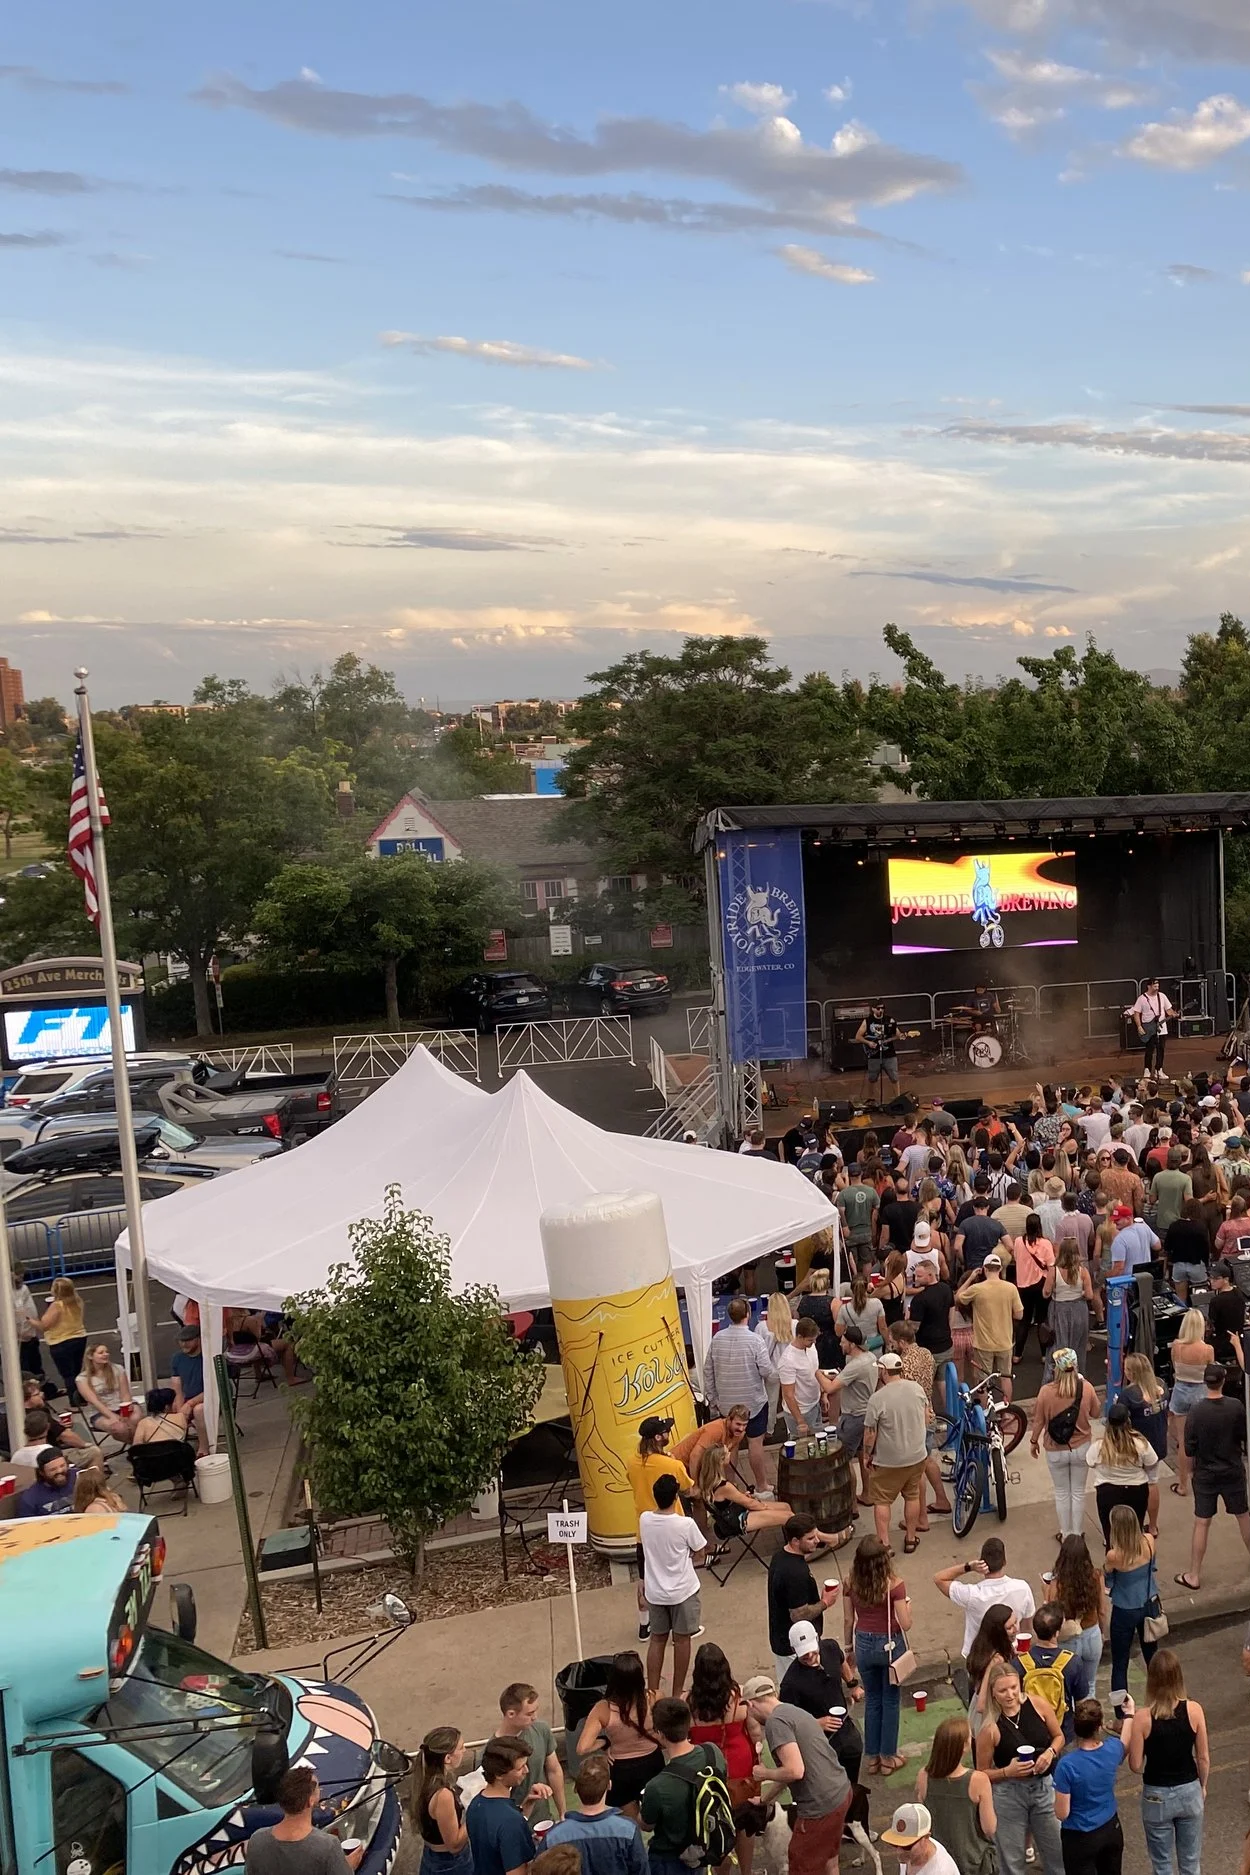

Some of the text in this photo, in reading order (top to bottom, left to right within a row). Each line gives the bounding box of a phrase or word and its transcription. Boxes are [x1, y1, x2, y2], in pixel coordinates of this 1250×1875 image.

[892, 890, 1076, 924] JOYRIDE BREWING
[726, 886, 801, 954] JOYRIDE BREWING
[736, 964, 783, 973] EDGEWATER,
[4, 974, 34, 992] 25th
[37, 971, 61, 983] Ave
[611, 1327, 681, 1366] ICE CUTTER
[555, 1519, 580, 1528] TRASH
[558, 1530, 577, 1538] ONLY
